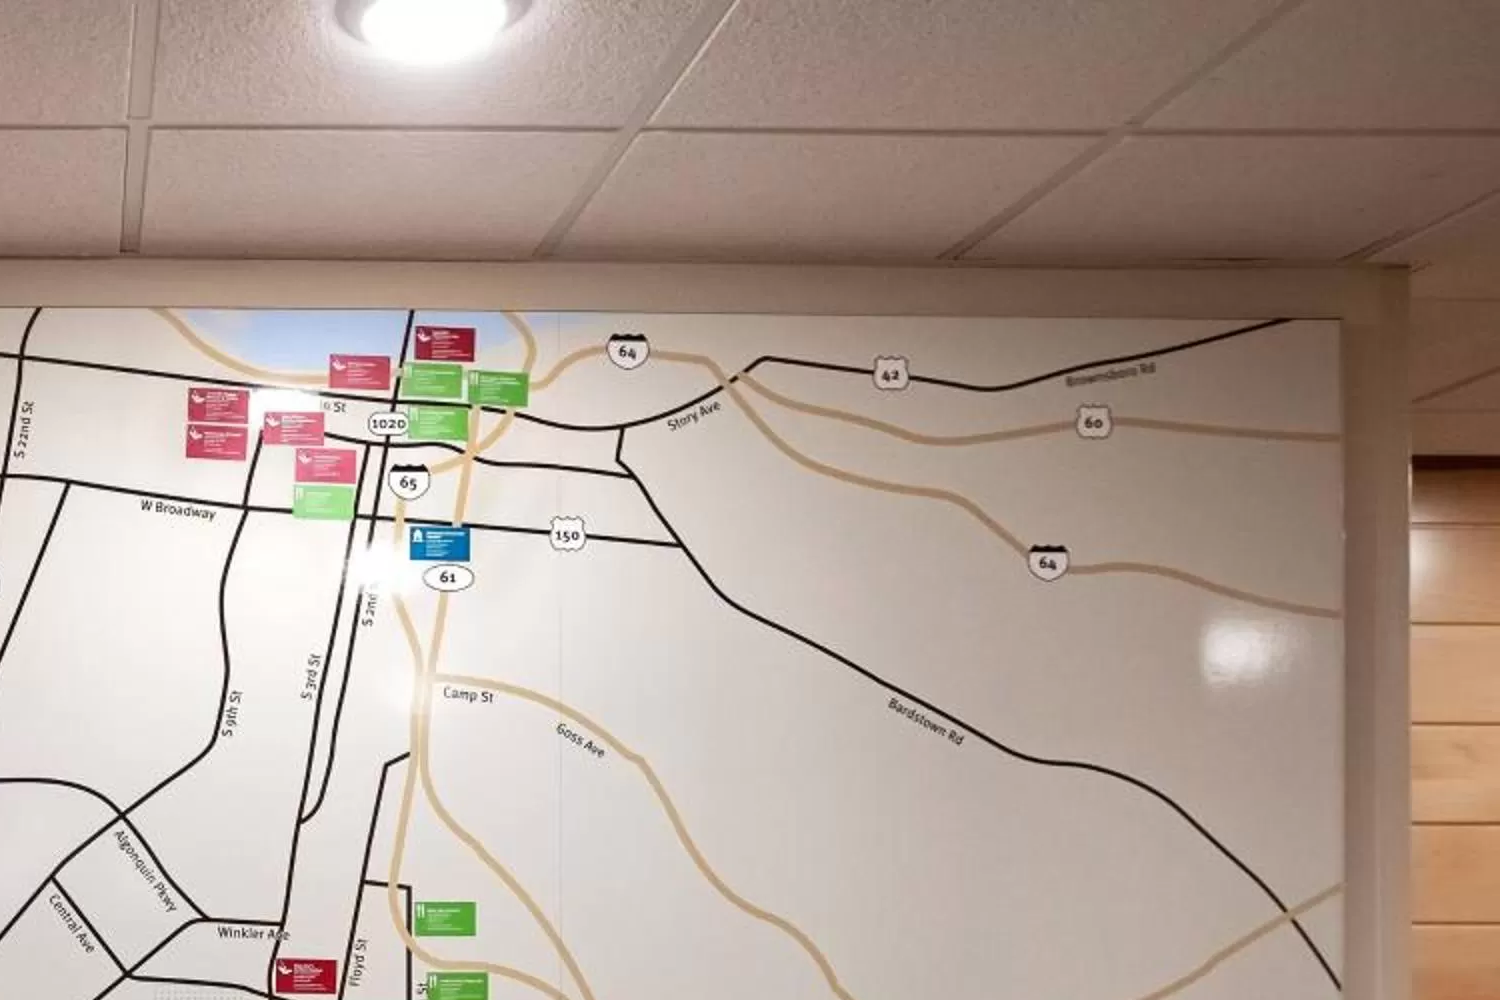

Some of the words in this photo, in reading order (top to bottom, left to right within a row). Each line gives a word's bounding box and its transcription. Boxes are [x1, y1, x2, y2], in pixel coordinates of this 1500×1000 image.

[619, 345, 637, 360] 64
[881, 369, 899, 382] 42
[21, 400, 35, 415] St
[371, 418, 406, 429] 1020
[667, 411, 699, 434] Story
[699, 401, 721, 417] Ave
[1083, 416, 1104, 429] 60
[16, 415, 31, 450] 22nd
[13, 449, 25, 458] S
[399, 475, 417, 491] 65
[140, 499, 153, 512] W
[154, 500, 216, 522] Broadway
[555, 530, 580, 543] 150
[1038, 557, 1057, 571] 64
[439, 571, 456, 584] 61
[308, 653, 322, 666] St
[304, 667, 319, 690] 3rd
[229, 691, 243, 705] St
[301, 690, 313, 700] S
[443, 686, 478, 704] Camp
[480, 690, 494, 704] St
[224, 706, 239, 728] 9th
[887, 697, 948, 738] Bardstown
[947, 727, 965, 746] Rd
[222, 727, 233, 737] S
[556, 722, 584, 746] Goss
[583, 739, 606, 759] Ave
[114, 829, 157, 885] Algonquin
[153, 880, 178, 914] Pkwy
[48, 893, 84, 935] Central
[76, 931, 96, 954] Ave
[217, 926, 264, 941] Winkler
[354, 938, 368, 951] St
[349, 951, 367, 988] Floyd
[418, 982, 430, 996] St
